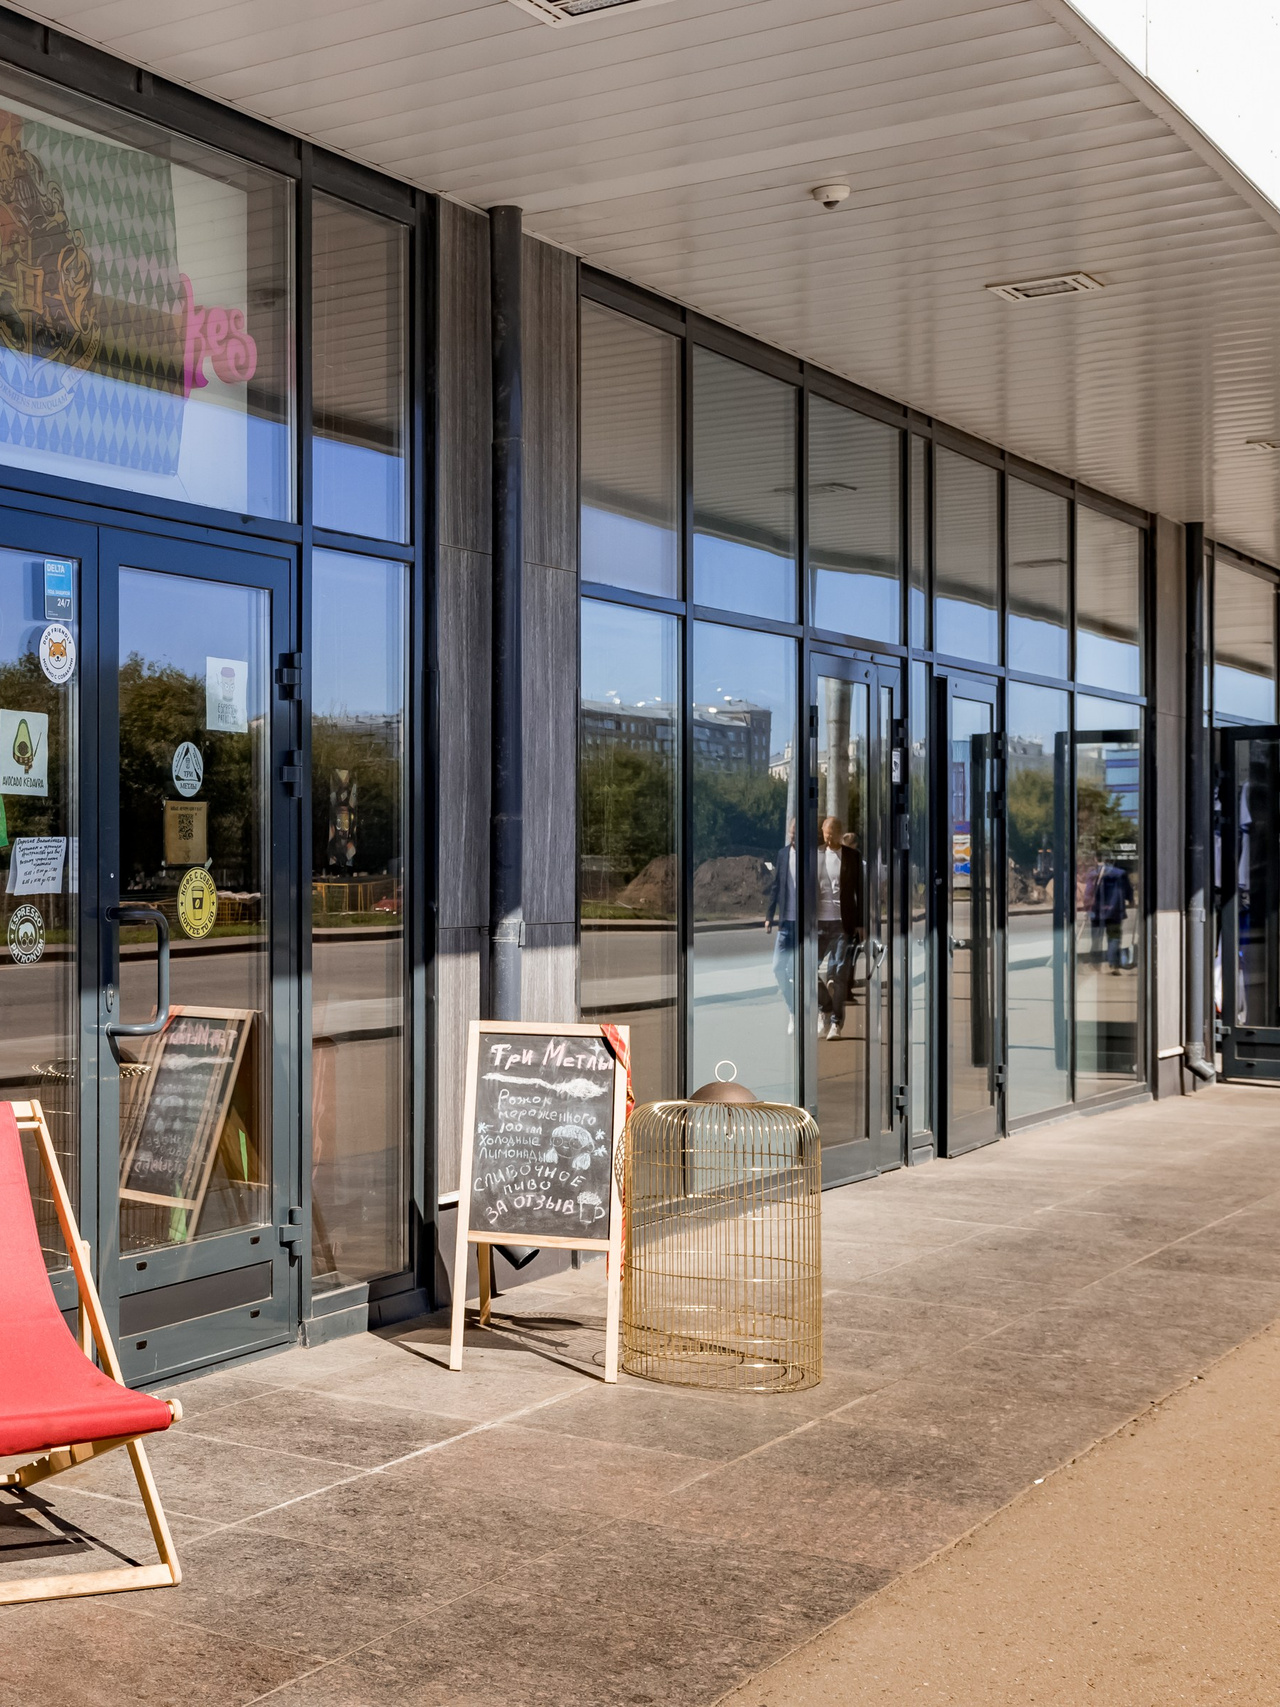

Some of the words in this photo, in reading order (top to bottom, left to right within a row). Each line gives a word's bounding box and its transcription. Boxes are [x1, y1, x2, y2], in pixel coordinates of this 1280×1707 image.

[46, 563, 66, 573] DELTA
[57, 598, 71, 608] 24/7
[2, 775, 22, 787] AVOCADO
[11, 906, 42, 930] ESPRESSO
[10, 938, 44, 963] PATRONUM
[490, 1043, 534, 1070] Три
[542, 1037, 614, 1071] Метлы
[485, 1199, 509, 1225] ЗА
[513, 1194, 575, 1215] ОТЗЫВ
